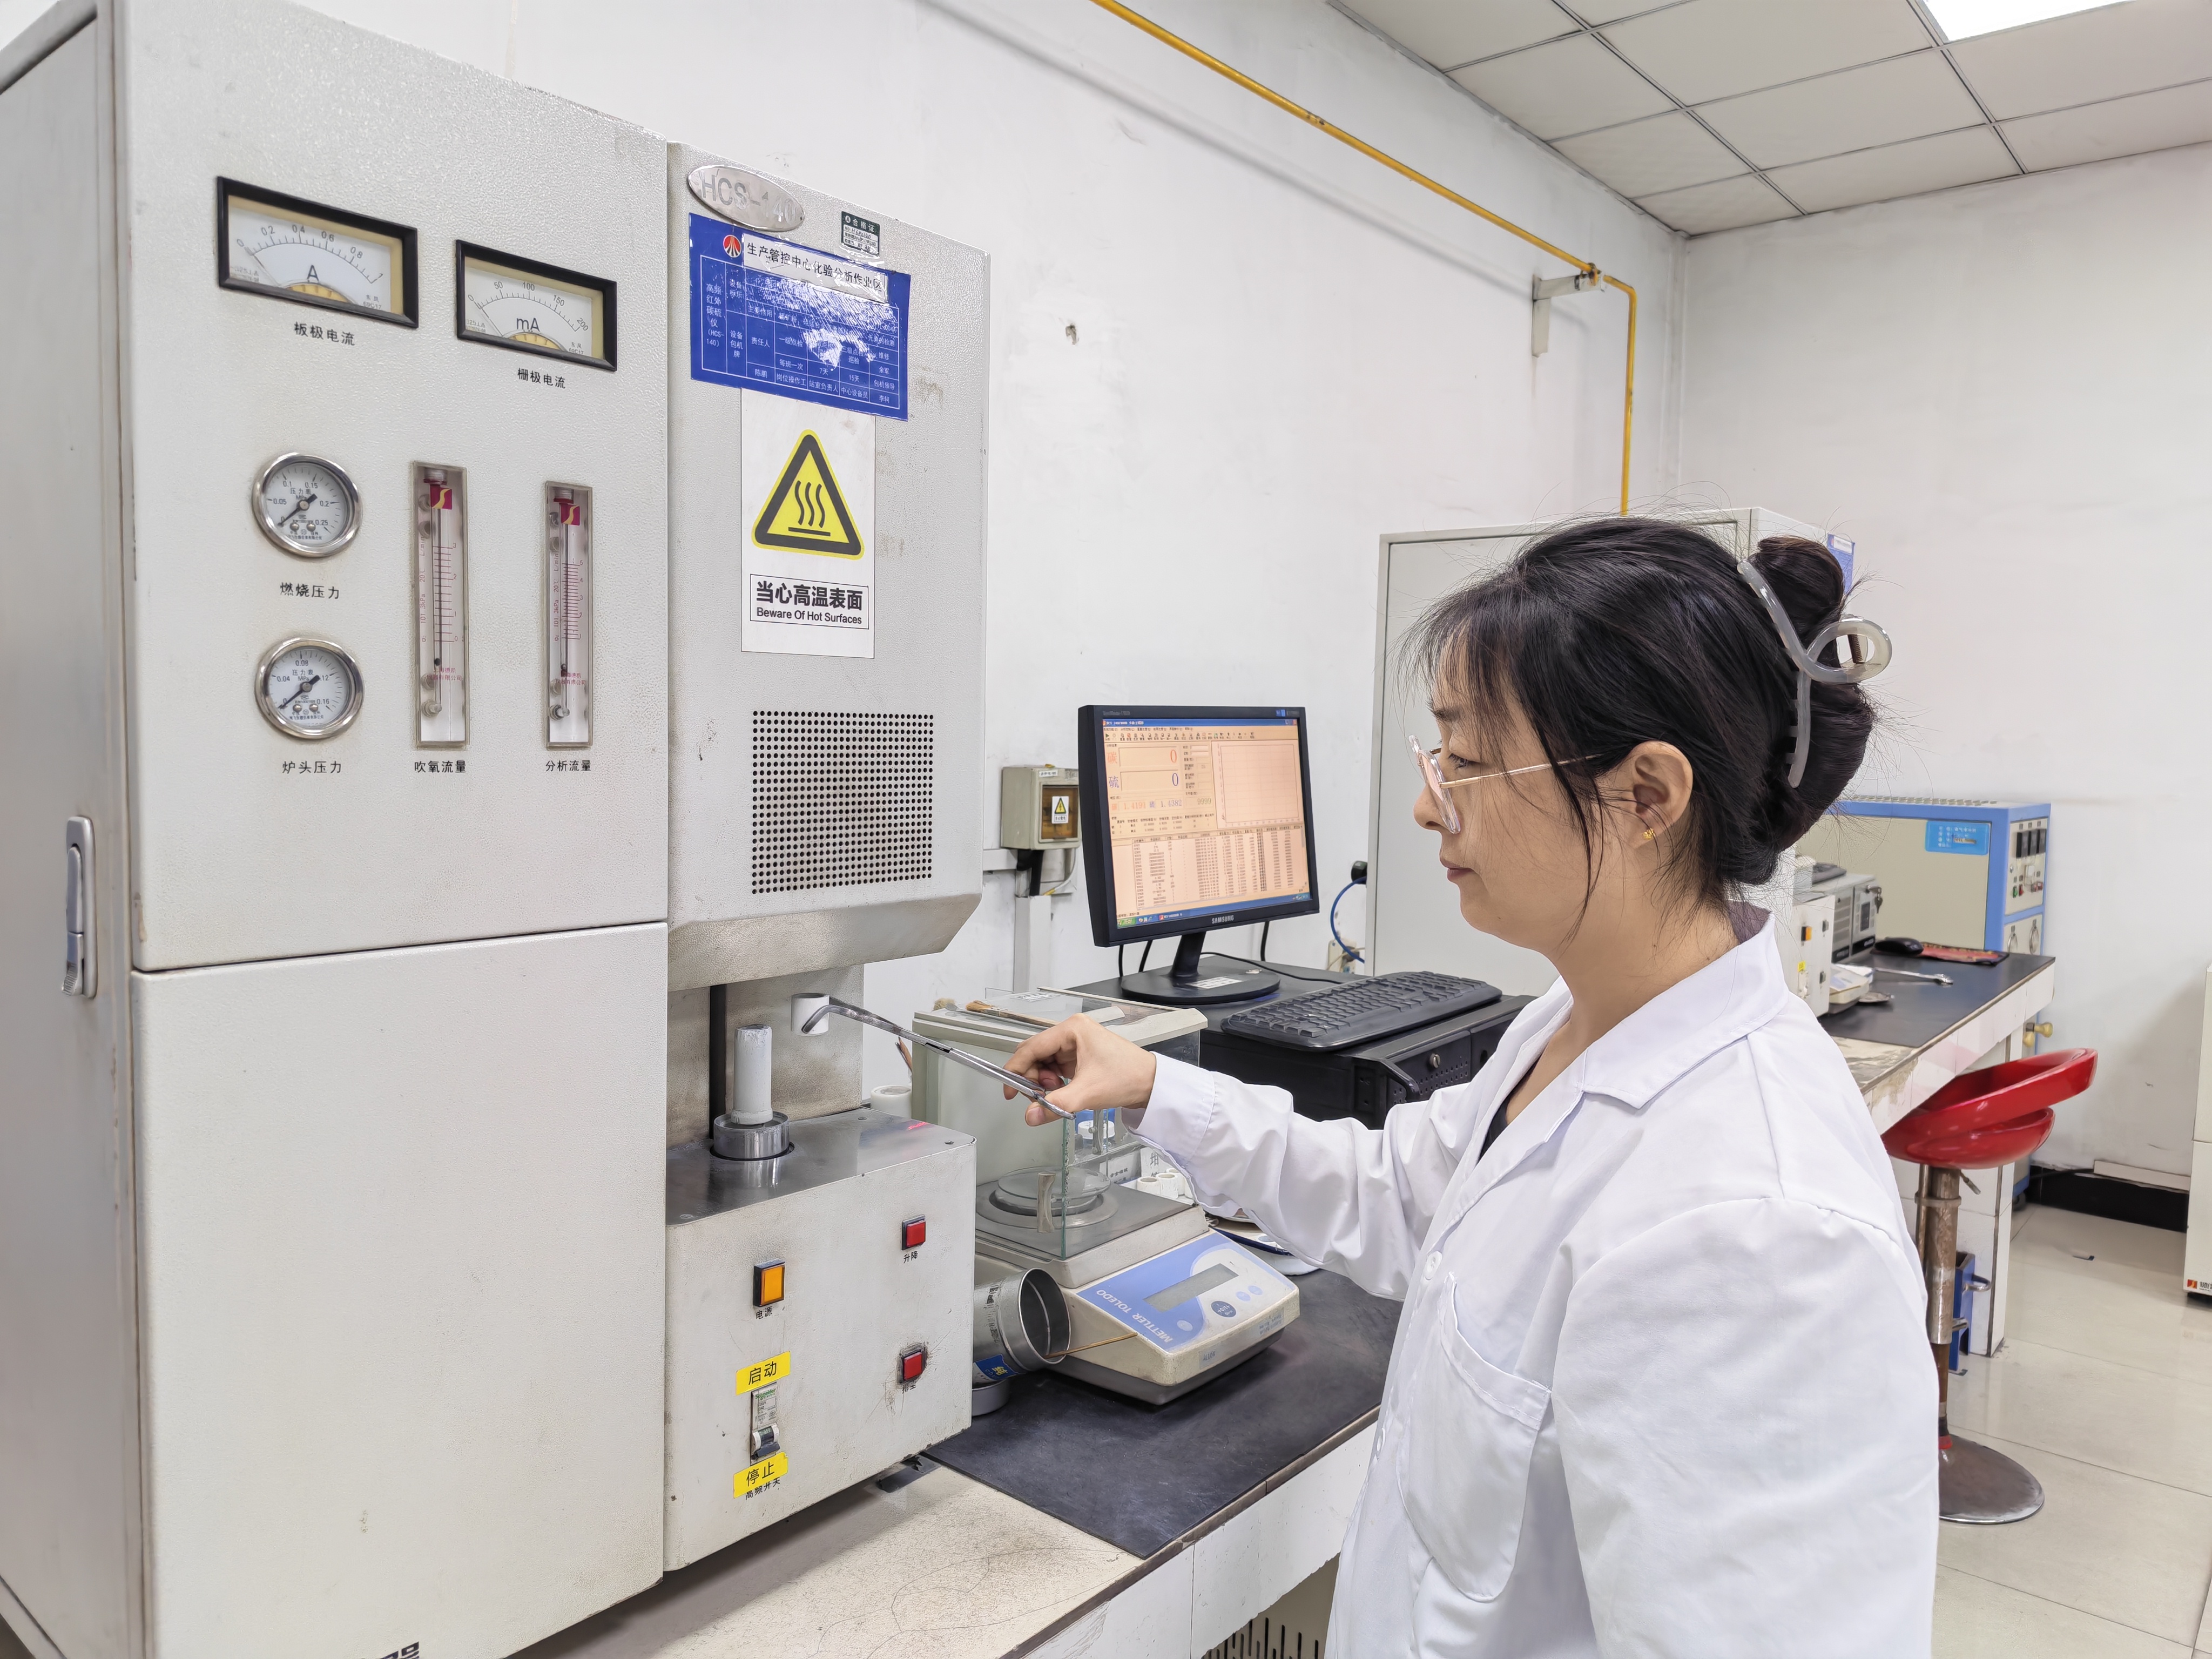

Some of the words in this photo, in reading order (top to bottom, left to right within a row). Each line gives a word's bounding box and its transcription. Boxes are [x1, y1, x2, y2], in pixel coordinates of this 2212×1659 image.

[853, 218, 875, 233] 合格证
[321, 231, 335, 242] 0.6
[350, 246, 363, 259] 0.8
[307, 265, 319, 281] A
[747, 242, 882, 292] 生产管控中心化验分析作业区
[494, 281, 503, 289] 50
[522, 281, 535, 291] 100
[706, 284, 721, 295] 高频
[552, 294, 565, 306] 150
[706, 295, 721, 306] 红外
[706, 306, 722, 318] 碳硫
[748, 305, 773, 318] 主要作用
[516, 318, 540, 332] mA
[577, 317, 589, 331] 200
[711, 318, 718, 328] 仪
[294, 322, 355, 346] 板极电流
[730, 330, 743, 340] 设备
[730, 340, 743, 350] 包机
[751, 337, 770, 348] 责任人
[779, 336, 803, 347] 一级点检
[848, 356, 859, 365] 巡检
[879, 352, 889, 360] 维修
[779, 359, 804, 370] 每班一次
[879, 366, 889, 375] 余军
[755, 368, 767, 378] 陈鹏
[819, 367, 828, 376] 7天
[517, 368, 566, 389] 栅极电流
[777, 373, 806, 386] 岗位操作工
[849, 374, 860, 383] 15天
[808, 380, 838, 393] 站室负责人
[874, 380, 895, 390] 包机领导
[841, 387, 868, 399] 中心设备员
[280, 582, 339, 599] 燃烧压力
[756, 581, 863, 611] 当心高温表面
[757, 607, 792, 619] Beware
[794, 610, 805, 620] Of
[807, 611, 822, 621] Hot
[825, 612, 862, 624] Surfaces
[1107, 751, 1117, 764] 碳
[1170, 749, 1177, 763] 0
[282, 760, 341, 774] 炉头压力
[414, 760, 467, 773] 吹氧流量
[545, 759, 591, 772] 分析流量
[1108, 775, 1120, 788] 硫
[1172, 773, 1178, 786] 0
[1123, 801, 1146, 810] 1.4191
[1161, 799, 1182, 808] 1.4382
[1197, 797, 1211, 806] 9999
[1211, 915, 1235, 924] SAMSUNG
[903, 1251, 918, 1264] 升降
[1096, 1289, 1132, 1313] TOLEDO
[756, 1306, 772, 1319] 电源
[1132, 1312, 1174, 1343] METTLER
[748, 1361, 777, 1385] 启动
[755, 1388, 776, 1400] Schneider
[746, 1461, 774, 1487] 停止
